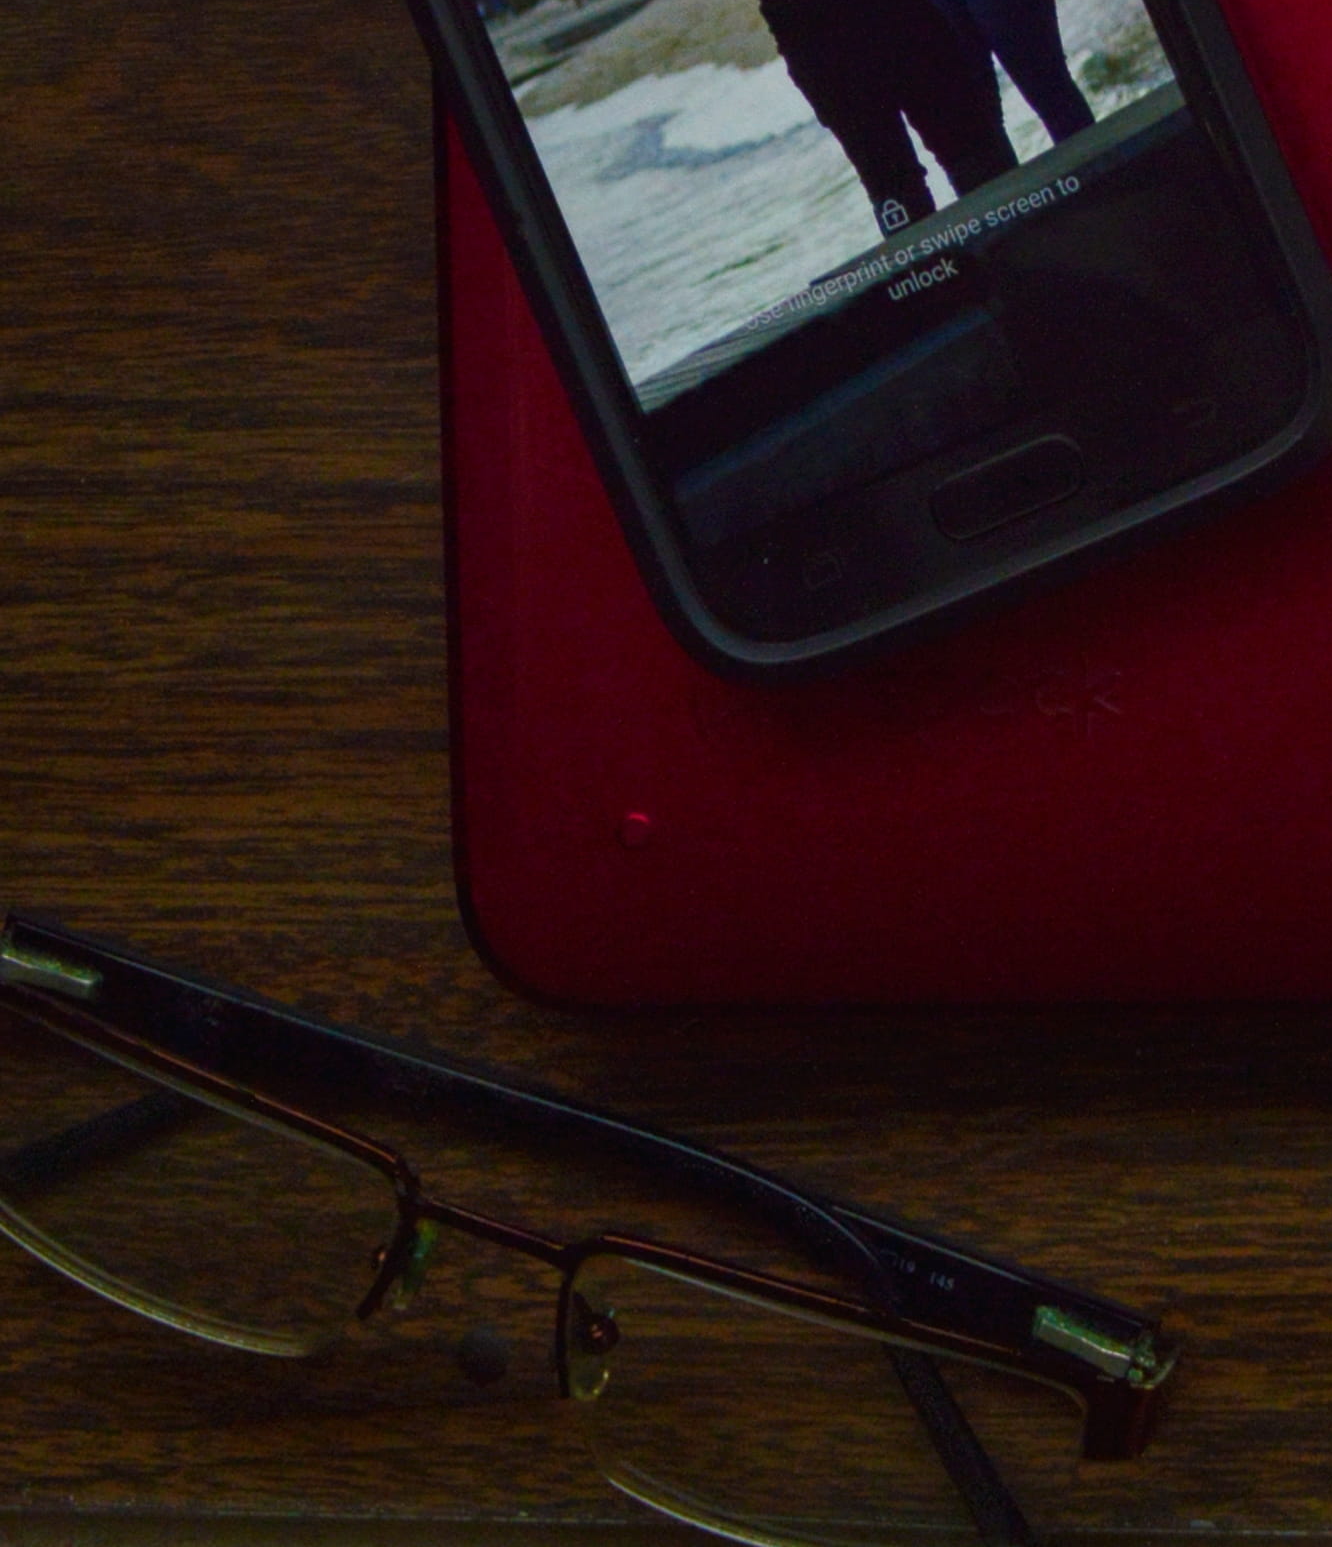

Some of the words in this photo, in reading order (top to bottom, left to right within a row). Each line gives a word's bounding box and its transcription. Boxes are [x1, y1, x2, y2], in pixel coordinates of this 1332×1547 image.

[895, 243, 915, 266] or
[921, 219, 981, 257] swipe
[985, 186, 1052, 229] screen
[1055, 174, 1081, 201] to
[887, 257, 960, 301] unlock
